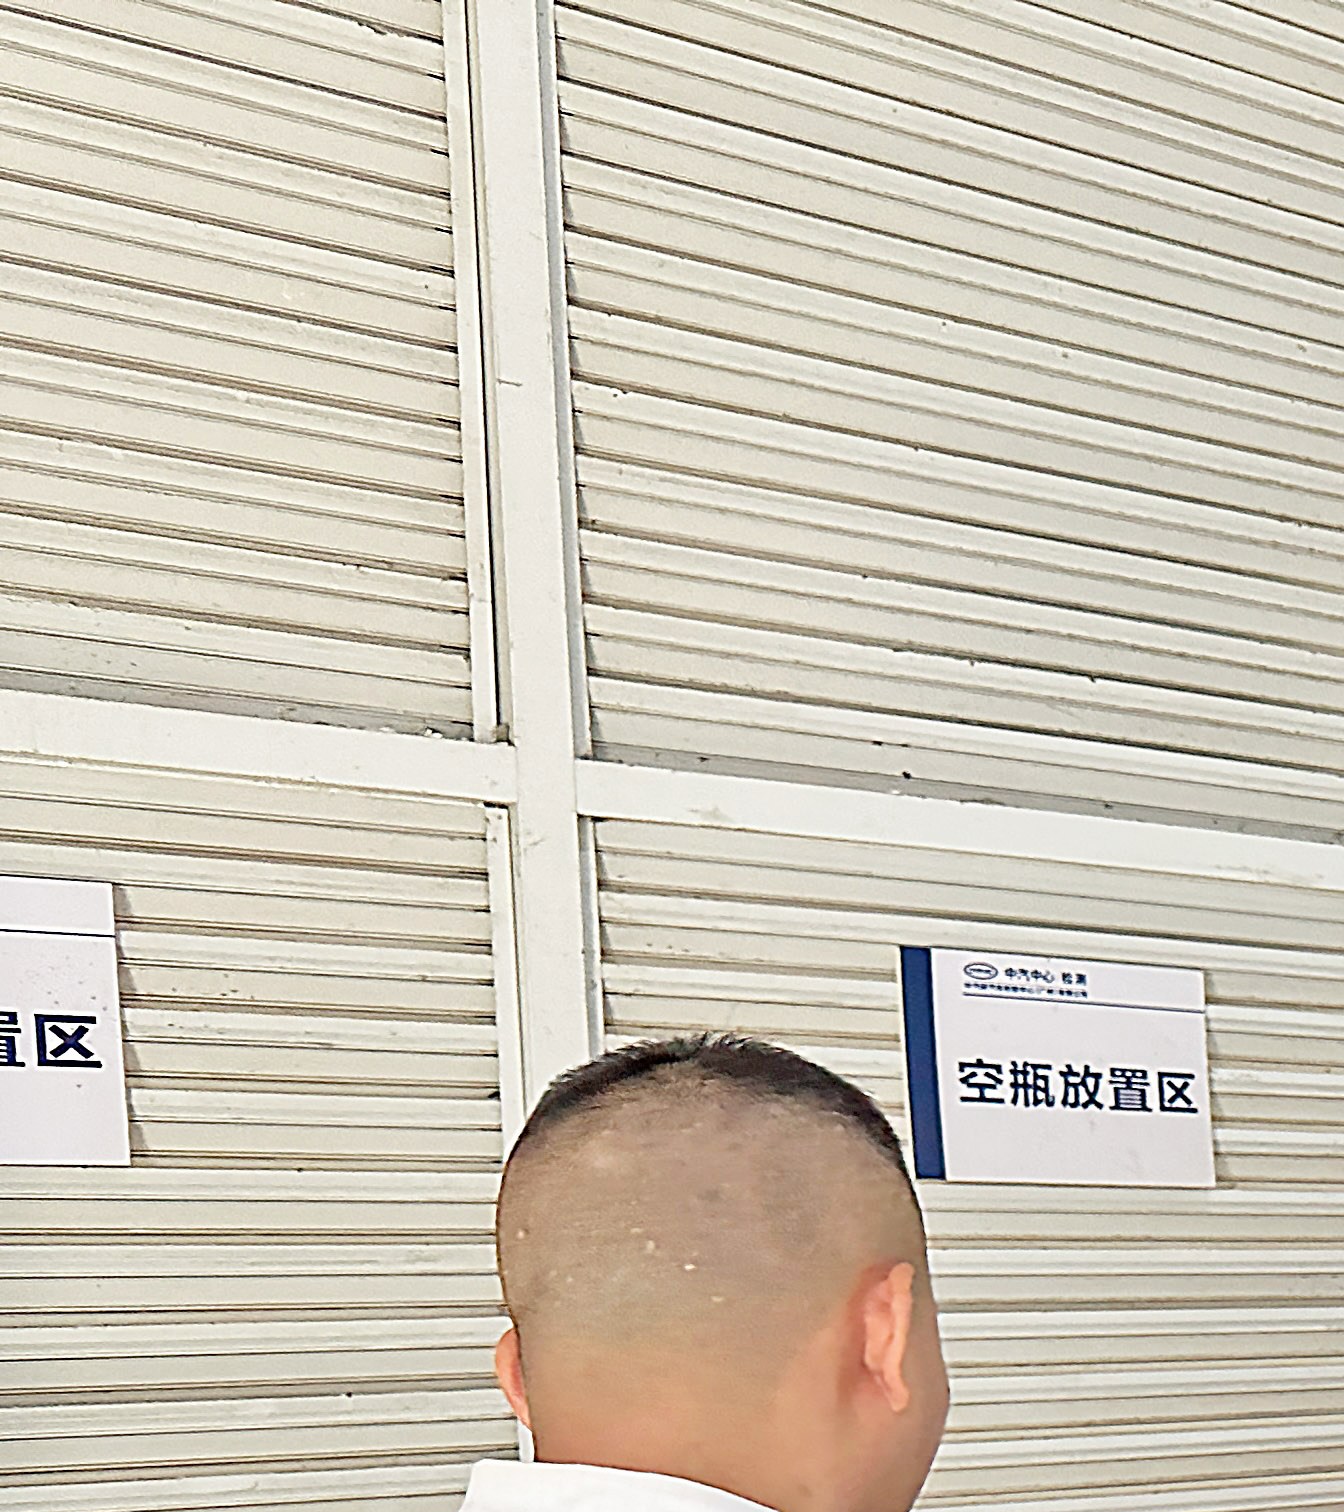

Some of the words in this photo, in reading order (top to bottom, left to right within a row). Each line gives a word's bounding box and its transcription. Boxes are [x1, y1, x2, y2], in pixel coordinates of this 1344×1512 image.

[958, 1058, 1199, 1113] 空瓶放置区
